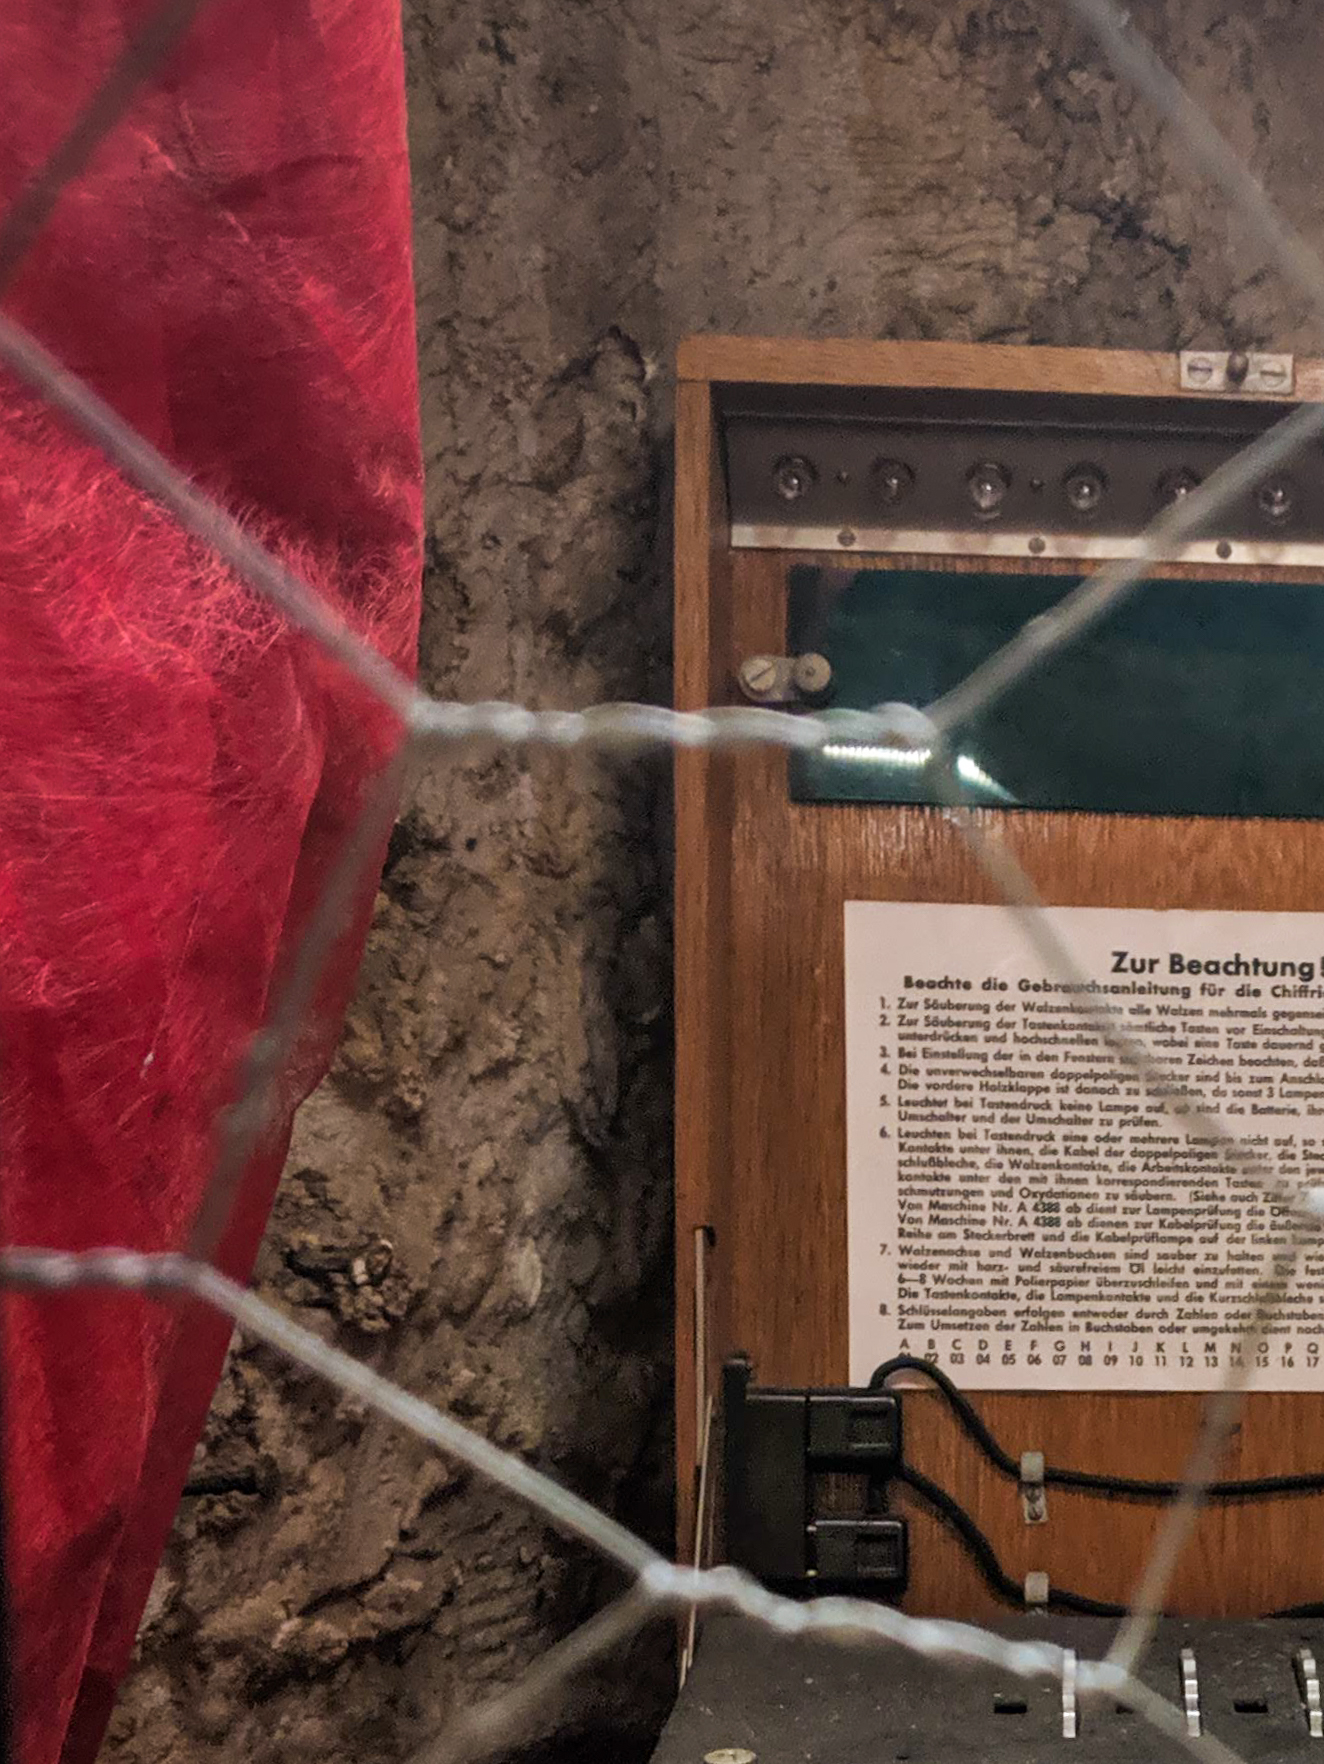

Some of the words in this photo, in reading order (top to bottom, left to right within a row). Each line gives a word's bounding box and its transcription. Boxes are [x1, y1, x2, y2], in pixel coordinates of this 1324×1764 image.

[1111, 952, 1160, 972] Zur
[902, 974, 972, 989] Beachte
[980, 976, 1009, 991] die
[1199, 982, 1226, 996] für
[1233, 983, 1263, 997] die
[879, 996, 891, 1008] 1.
[896, 997, 919, 1009] Zur
[922, 998, 991, 1014] Säuberung
[994, 1000, 1017, 1012] der
[1127, 1003, 1152, 1015] alle
[1155, 1004, 1205, 1016] Walzen
[1207, 1005, 1268, 1017] mehrmals
[897, 1304, 1007, 1319] Schlüsselangaben
[1012, 1306, 1065, 1320] erfolgen
[1071, 1306, 1128, 1318] entweder
[1134, 1307, 1169, 1319] durch
[1176, 1307, 1218, 1319] Zahlen
[1223, 1308, 1252, 1319] oder
[897, 1318, 925, 1330] Zum
[930, 1319, 990, 1330] Umsetzen
[994, 1319, 1015, 1331] der
[1021, 1320, 1063, 1332] Zahlen
[1068, 1320, 1080, 1332] in
[1084, 1321, 1153, 1333] Buchstaben
[1158, 1321, 1186, 1333] oder
[1260, 1322, 1291, 1334] dient
[899, 1337, 909, 1349] A
[927, 1338, 936, 1349] B
[951, 1338, 962, 1350] C
[977, 1338, 988, 1350] D
[1003, 1339, 1012, 1350] E
[1029, 1339, 1038, 1351] F
[1053, 1340, 1065, 1351] G
[1080, 1340, 1091, 1351] H
[1107, 1340, 1113, 1352] I
[1132, 1341, 1138, 1352] J
[1155, 1341, 1165, 1352] K
[1181, 1341, 1187, 1352] L
[1203, 1341, 1216, 1353] M
[1230, 1341, 1242, 1353] N
[1257, 1342, 1269, 1353] O
[1284, 1342, 1292, 1353] P
[1306, 1342, 1319, 1353] Q
[949, 1352, 964, 1364] 03
[975, 1352, 990, 1364] 04
[1001, 1353, 1016, 1364] 05
[1026, 1353, 1041, 1365] 06
[1052, 1353, 1066, 1365] 07
[1103, 1354, 1118, 1366] 09
[1129, 1354, 1143, 1366] 10
[1154, 1355, 1166, 1366] 11
[1179, 1355, 1193, 1366] 12
[1204, 1355, 1218, 1367] 13
[1256, 1356, 1268, 1367] 15
[1281, 1356, 1294, 1367] 16
[1306, 1356, 1318, 1367] 17
